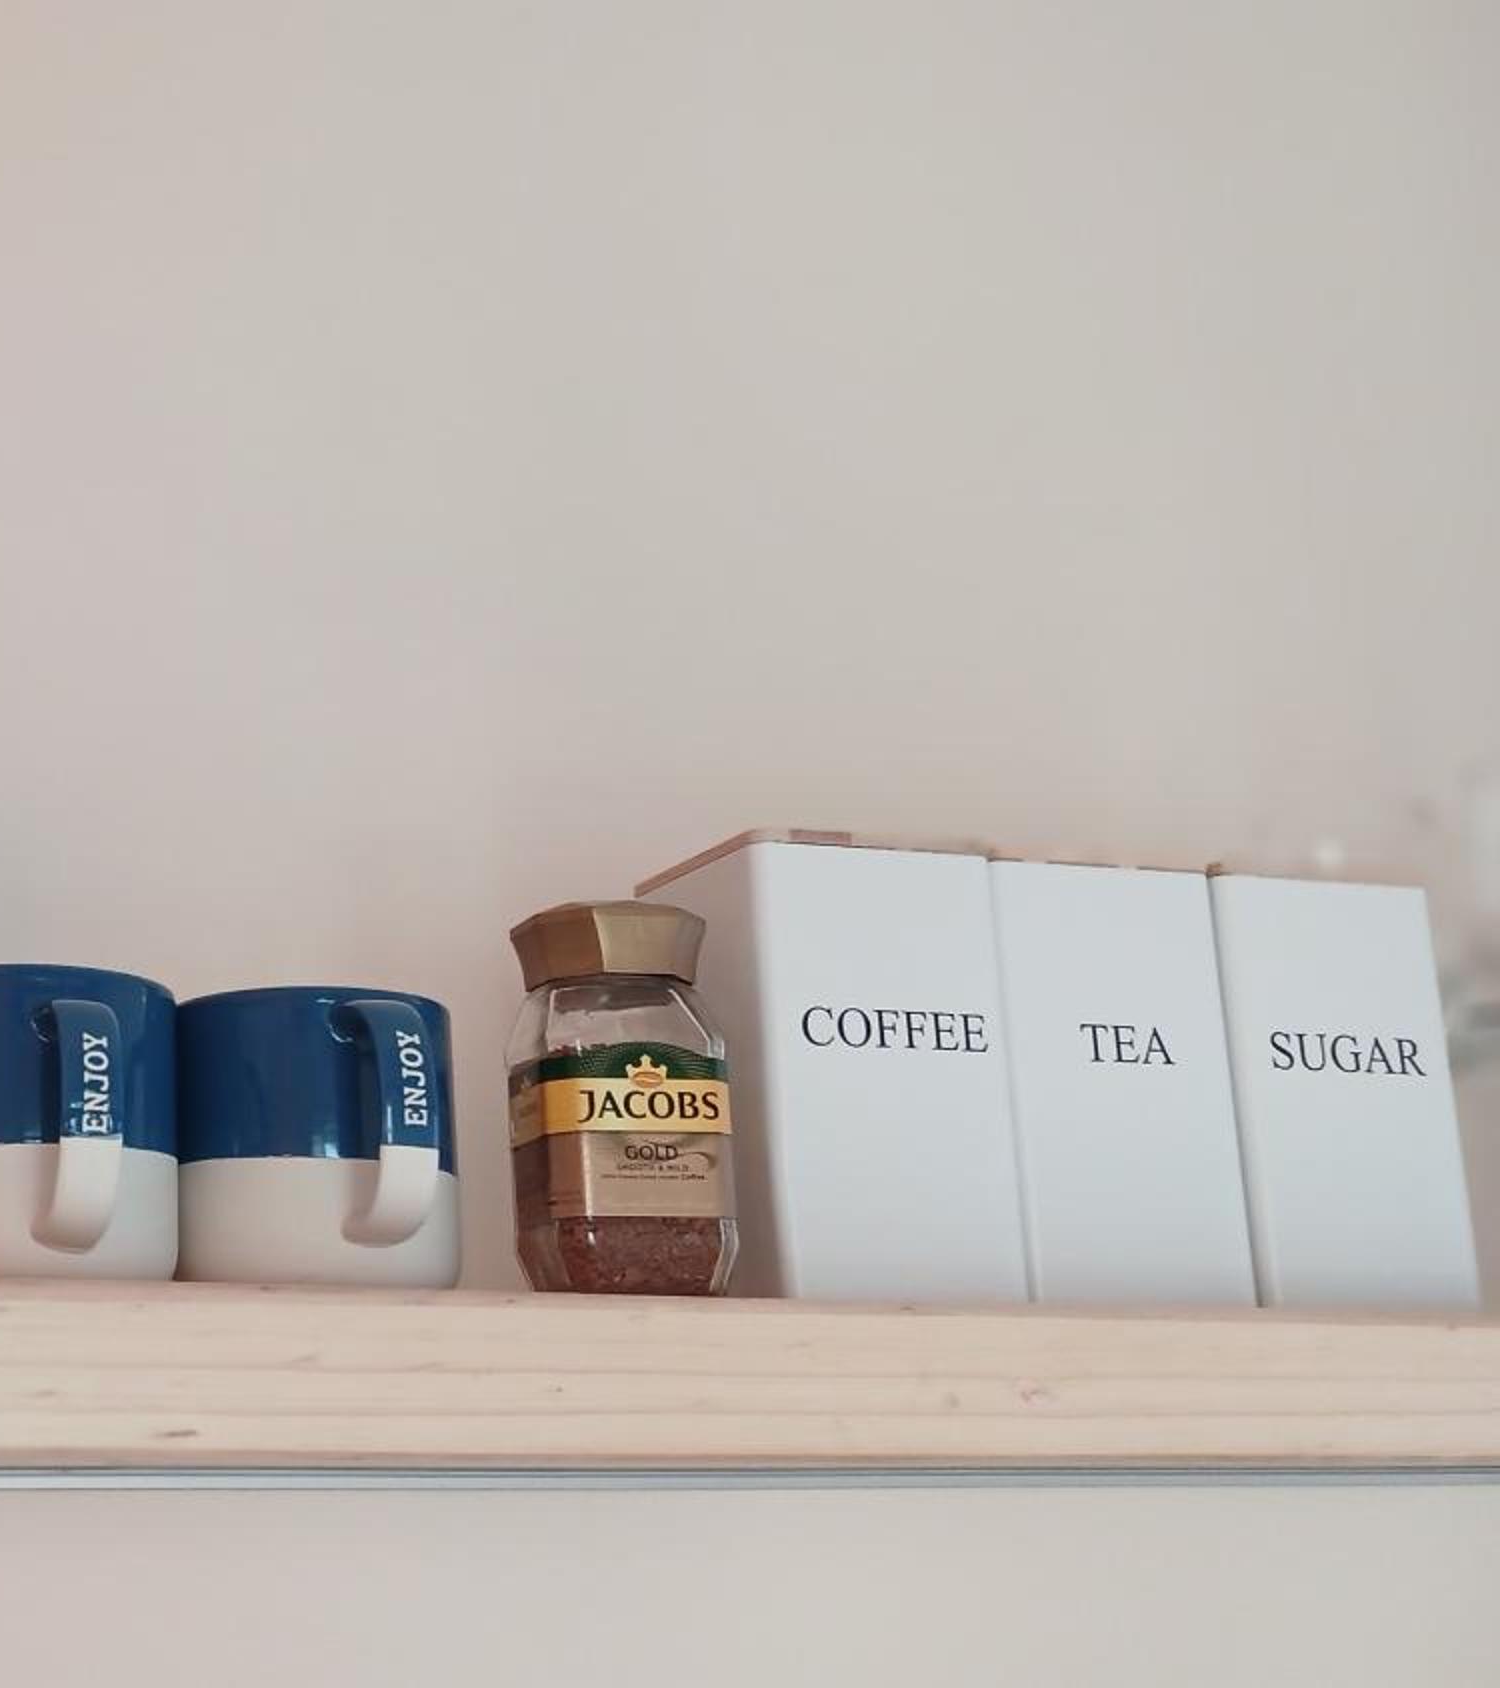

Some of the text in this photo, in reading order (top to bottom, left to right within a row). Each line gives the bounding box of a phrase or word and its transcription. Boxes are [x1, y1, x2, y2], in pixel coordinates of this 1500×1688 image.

[801, 1006, 989, 1052] COFFEE
[1079, 1024, 1175, 1064] TEA
[1270, 1031, 1427, 1077] SUGAR
[83, 1032, 111, 1133] ENJOY
[396, 1030, 428, 1126] ENJOY
[578, 1090, 719, 1123] JACOBS
[625, 1145, 678, 1160] GOLD
